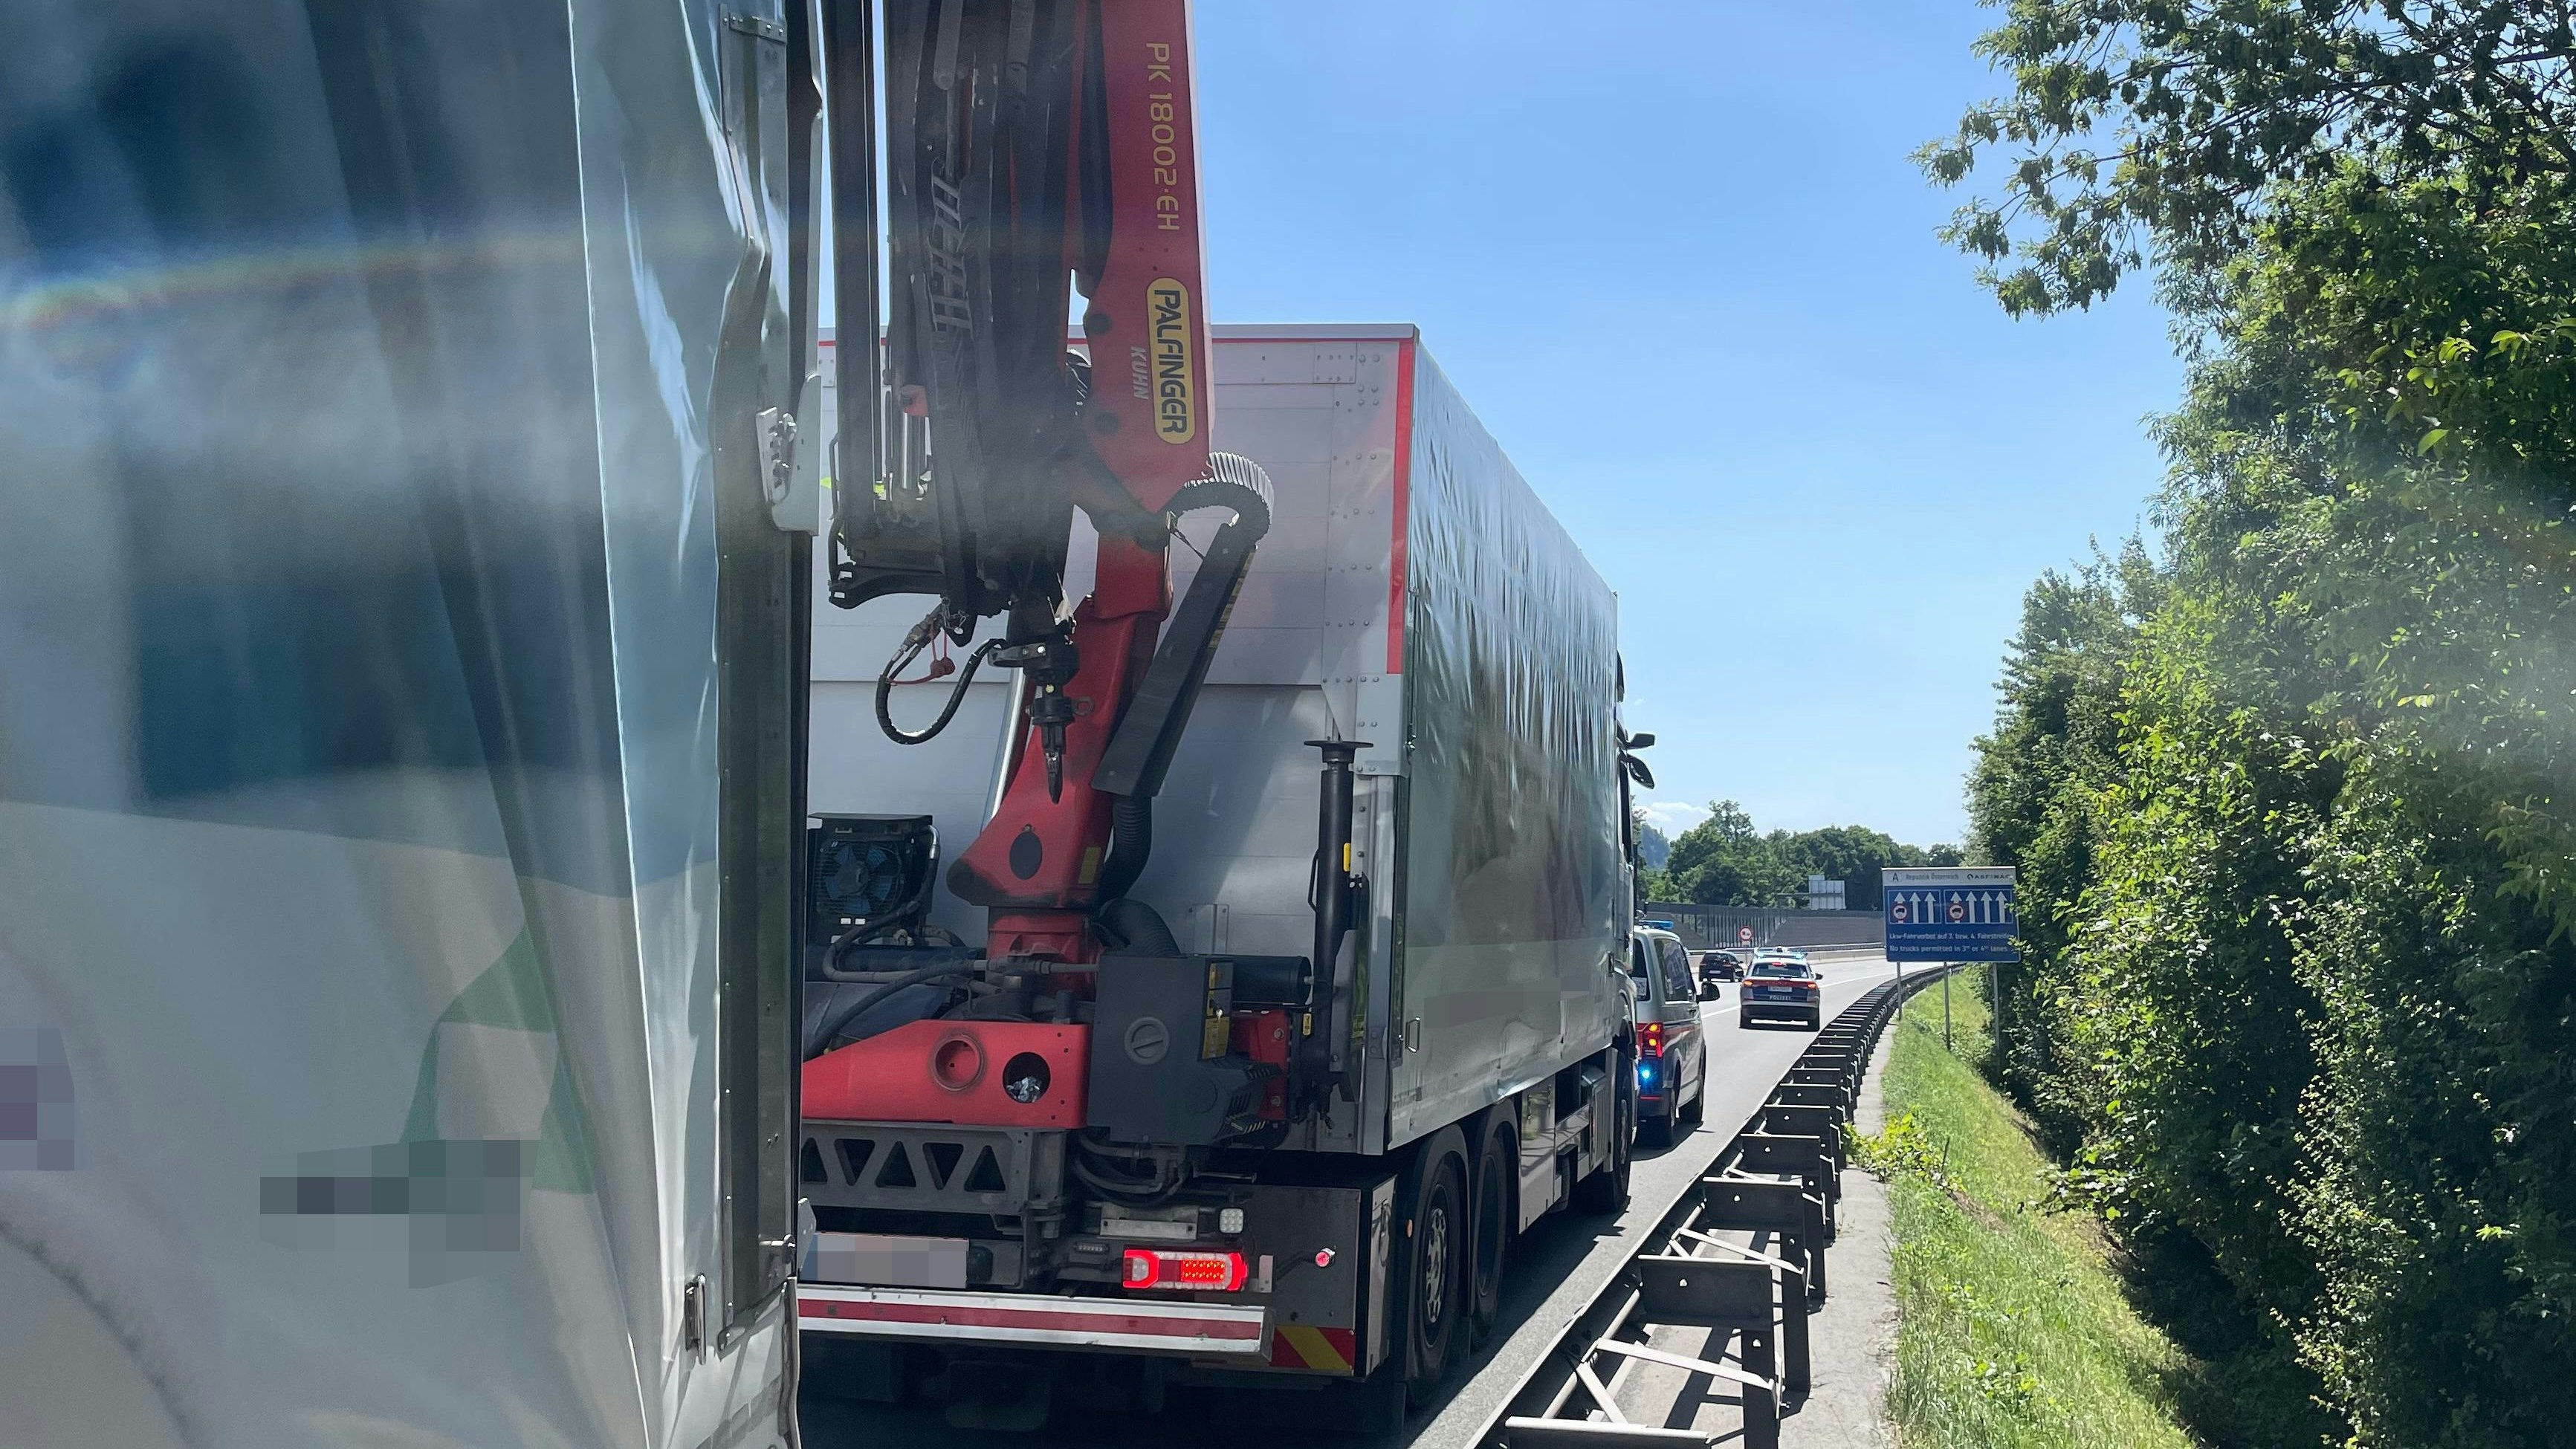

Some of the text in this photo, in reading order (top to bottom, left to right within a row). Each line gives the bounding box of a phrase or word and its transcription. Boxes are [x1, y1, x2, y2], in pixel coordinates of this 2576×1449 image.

[1145, 42, 1171, 82] PK
[1130, 346, 1149, 400] KUHN
[1153, 289, 1188, 434] PALFINGER
[1892, 872, 1899, 882] A
